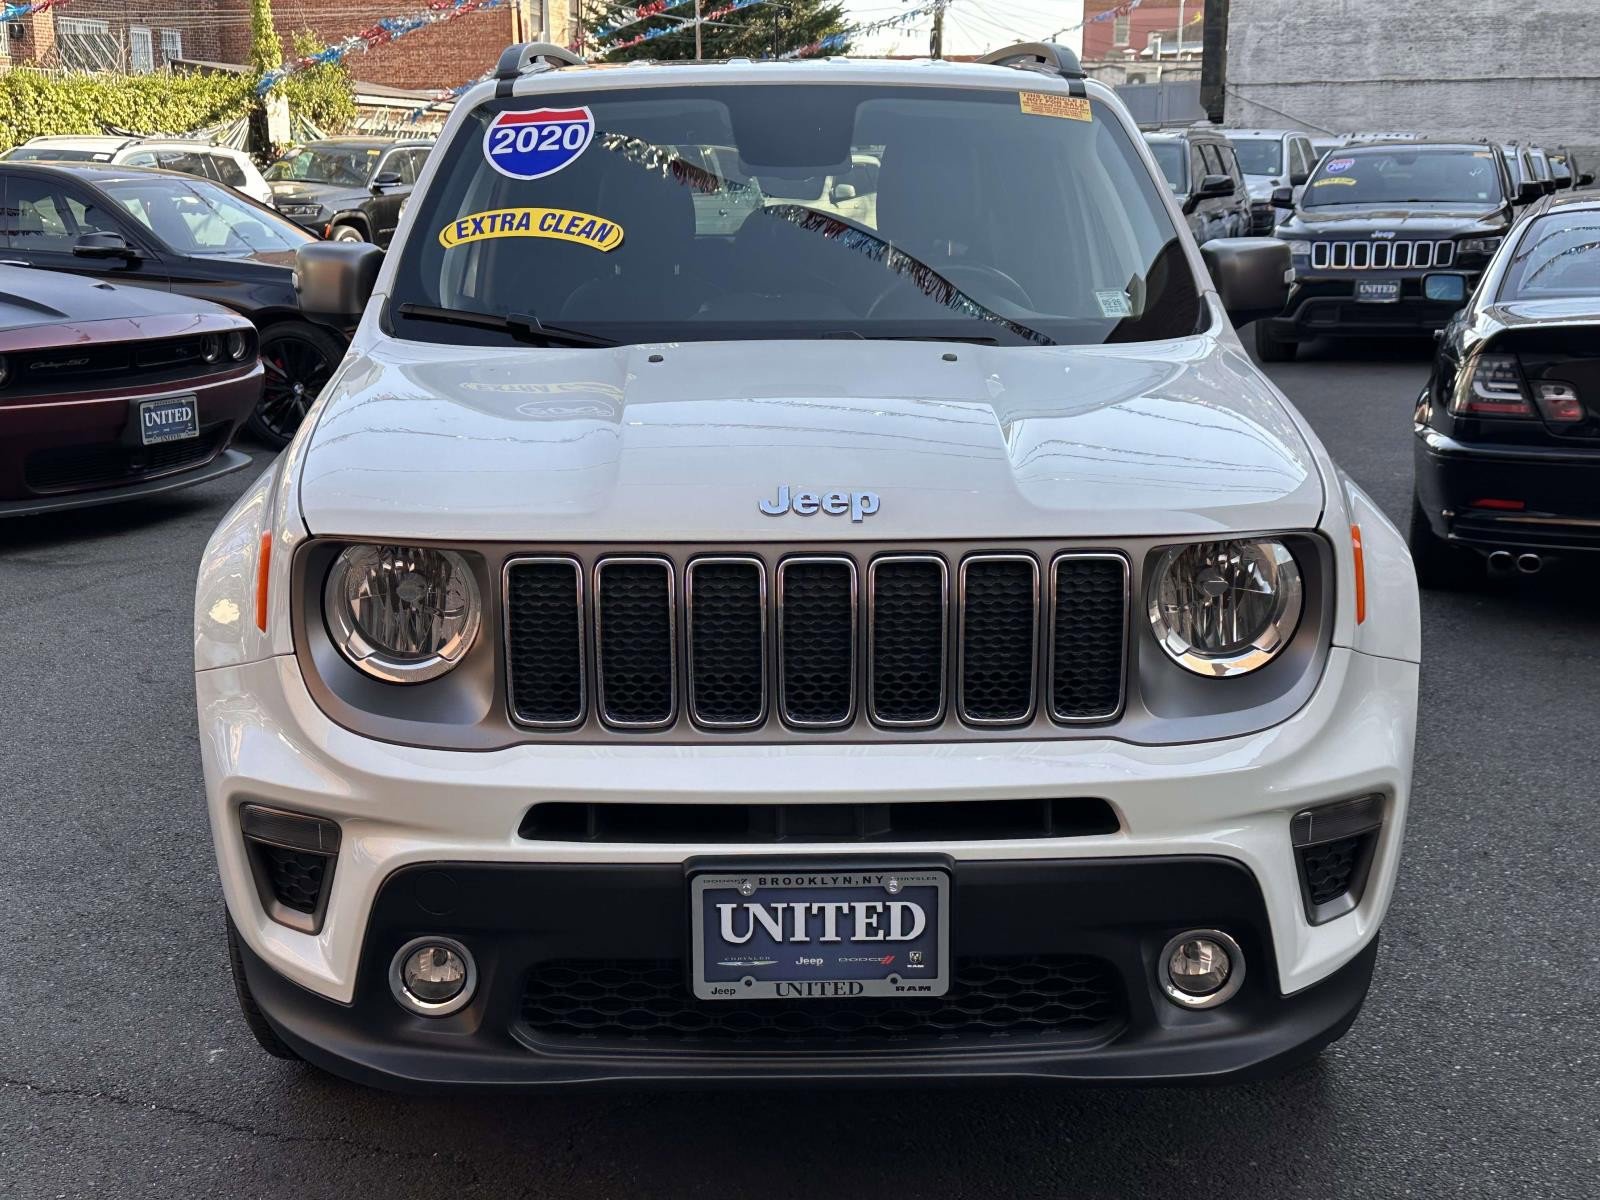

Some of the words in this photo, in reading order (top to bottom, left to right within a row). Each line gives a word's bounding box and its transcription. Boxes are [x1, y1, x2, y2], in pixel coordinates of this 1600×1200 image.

[492, 124, 586, 155] 2020
[456, 211, 530, 240] EXTRA
[538, 212, 614, 243] CLEAN
[1359, 284, 1397, 293] UNITED
[144, 406, 192, 427] UNITED
[759, 484, 880, 523] Jeep
[716, 901, 926, 944] UNITED
[795, 956, 824, 967] Jeep
[711, 986, 736, 996] Jeep
[774, 981, 864, 997] UNITED
